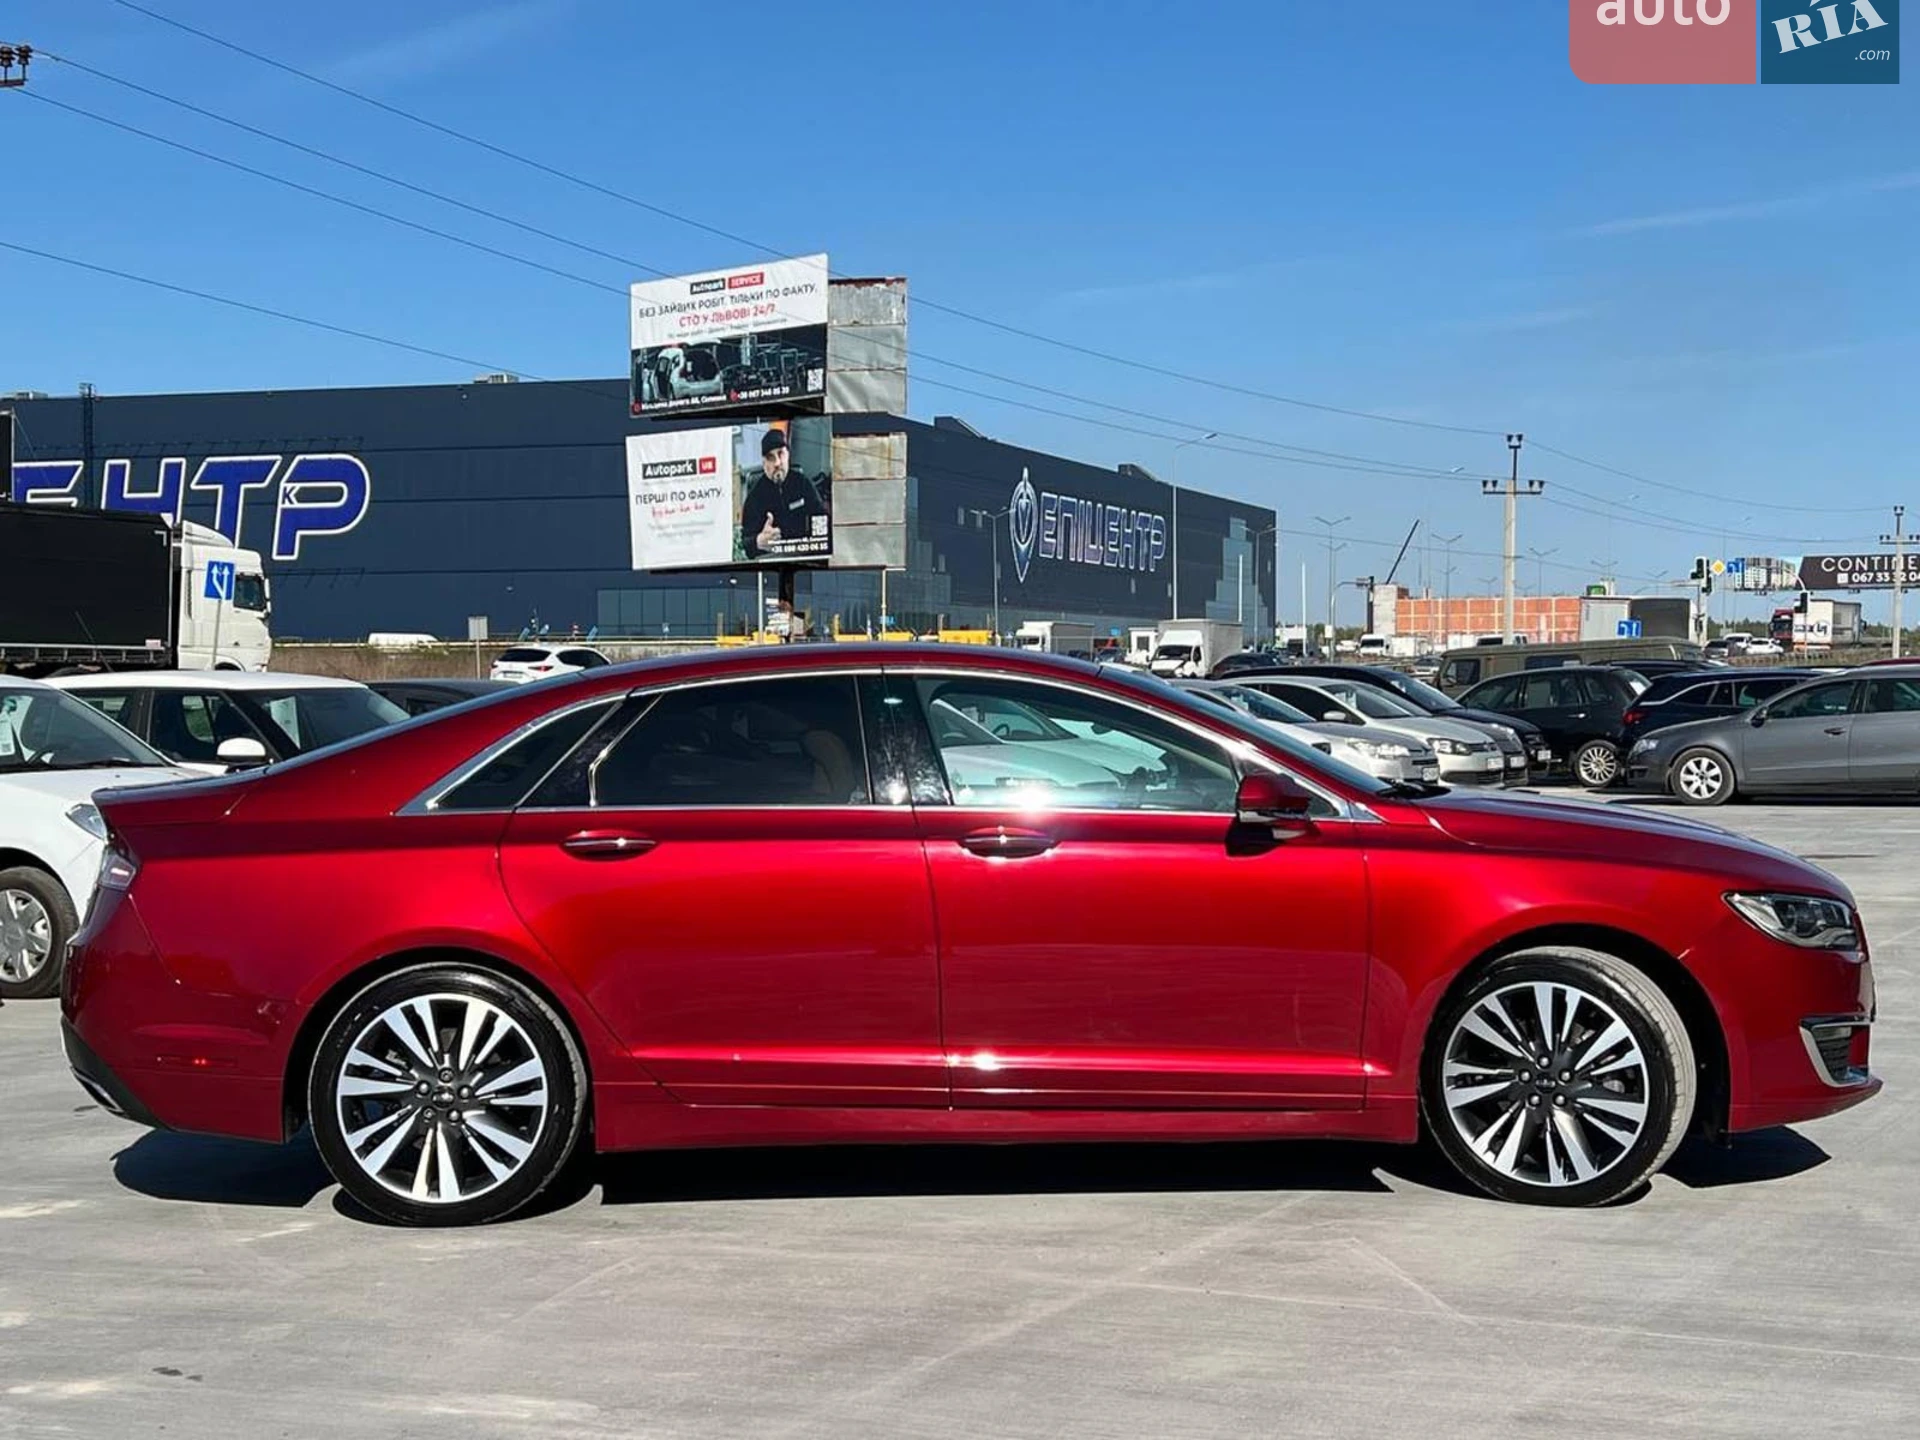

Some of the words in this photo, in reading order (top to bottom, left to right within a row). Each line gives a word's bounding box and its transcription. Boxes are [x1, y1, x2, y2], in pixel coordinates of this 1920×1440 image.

[639, 307, 656, 319] БЕЗ
[765, 288, 780, 299] ПО
[679, 314, 700, 328] СТО
[702, 313, 709, 324] У
[711, 306, 750, 323] ЛЬВОВІ
[644, 460, 694, 478] Autopark
[635, 492, 669, 506] ПЕРШІ
[670, 490, 687, 503] ПО
[1038, 491, 1167, 573] ЕПІЦЕНТР
[1852, 571, 1875, 582] 067
[1876, 571, 1890, 582] 33
